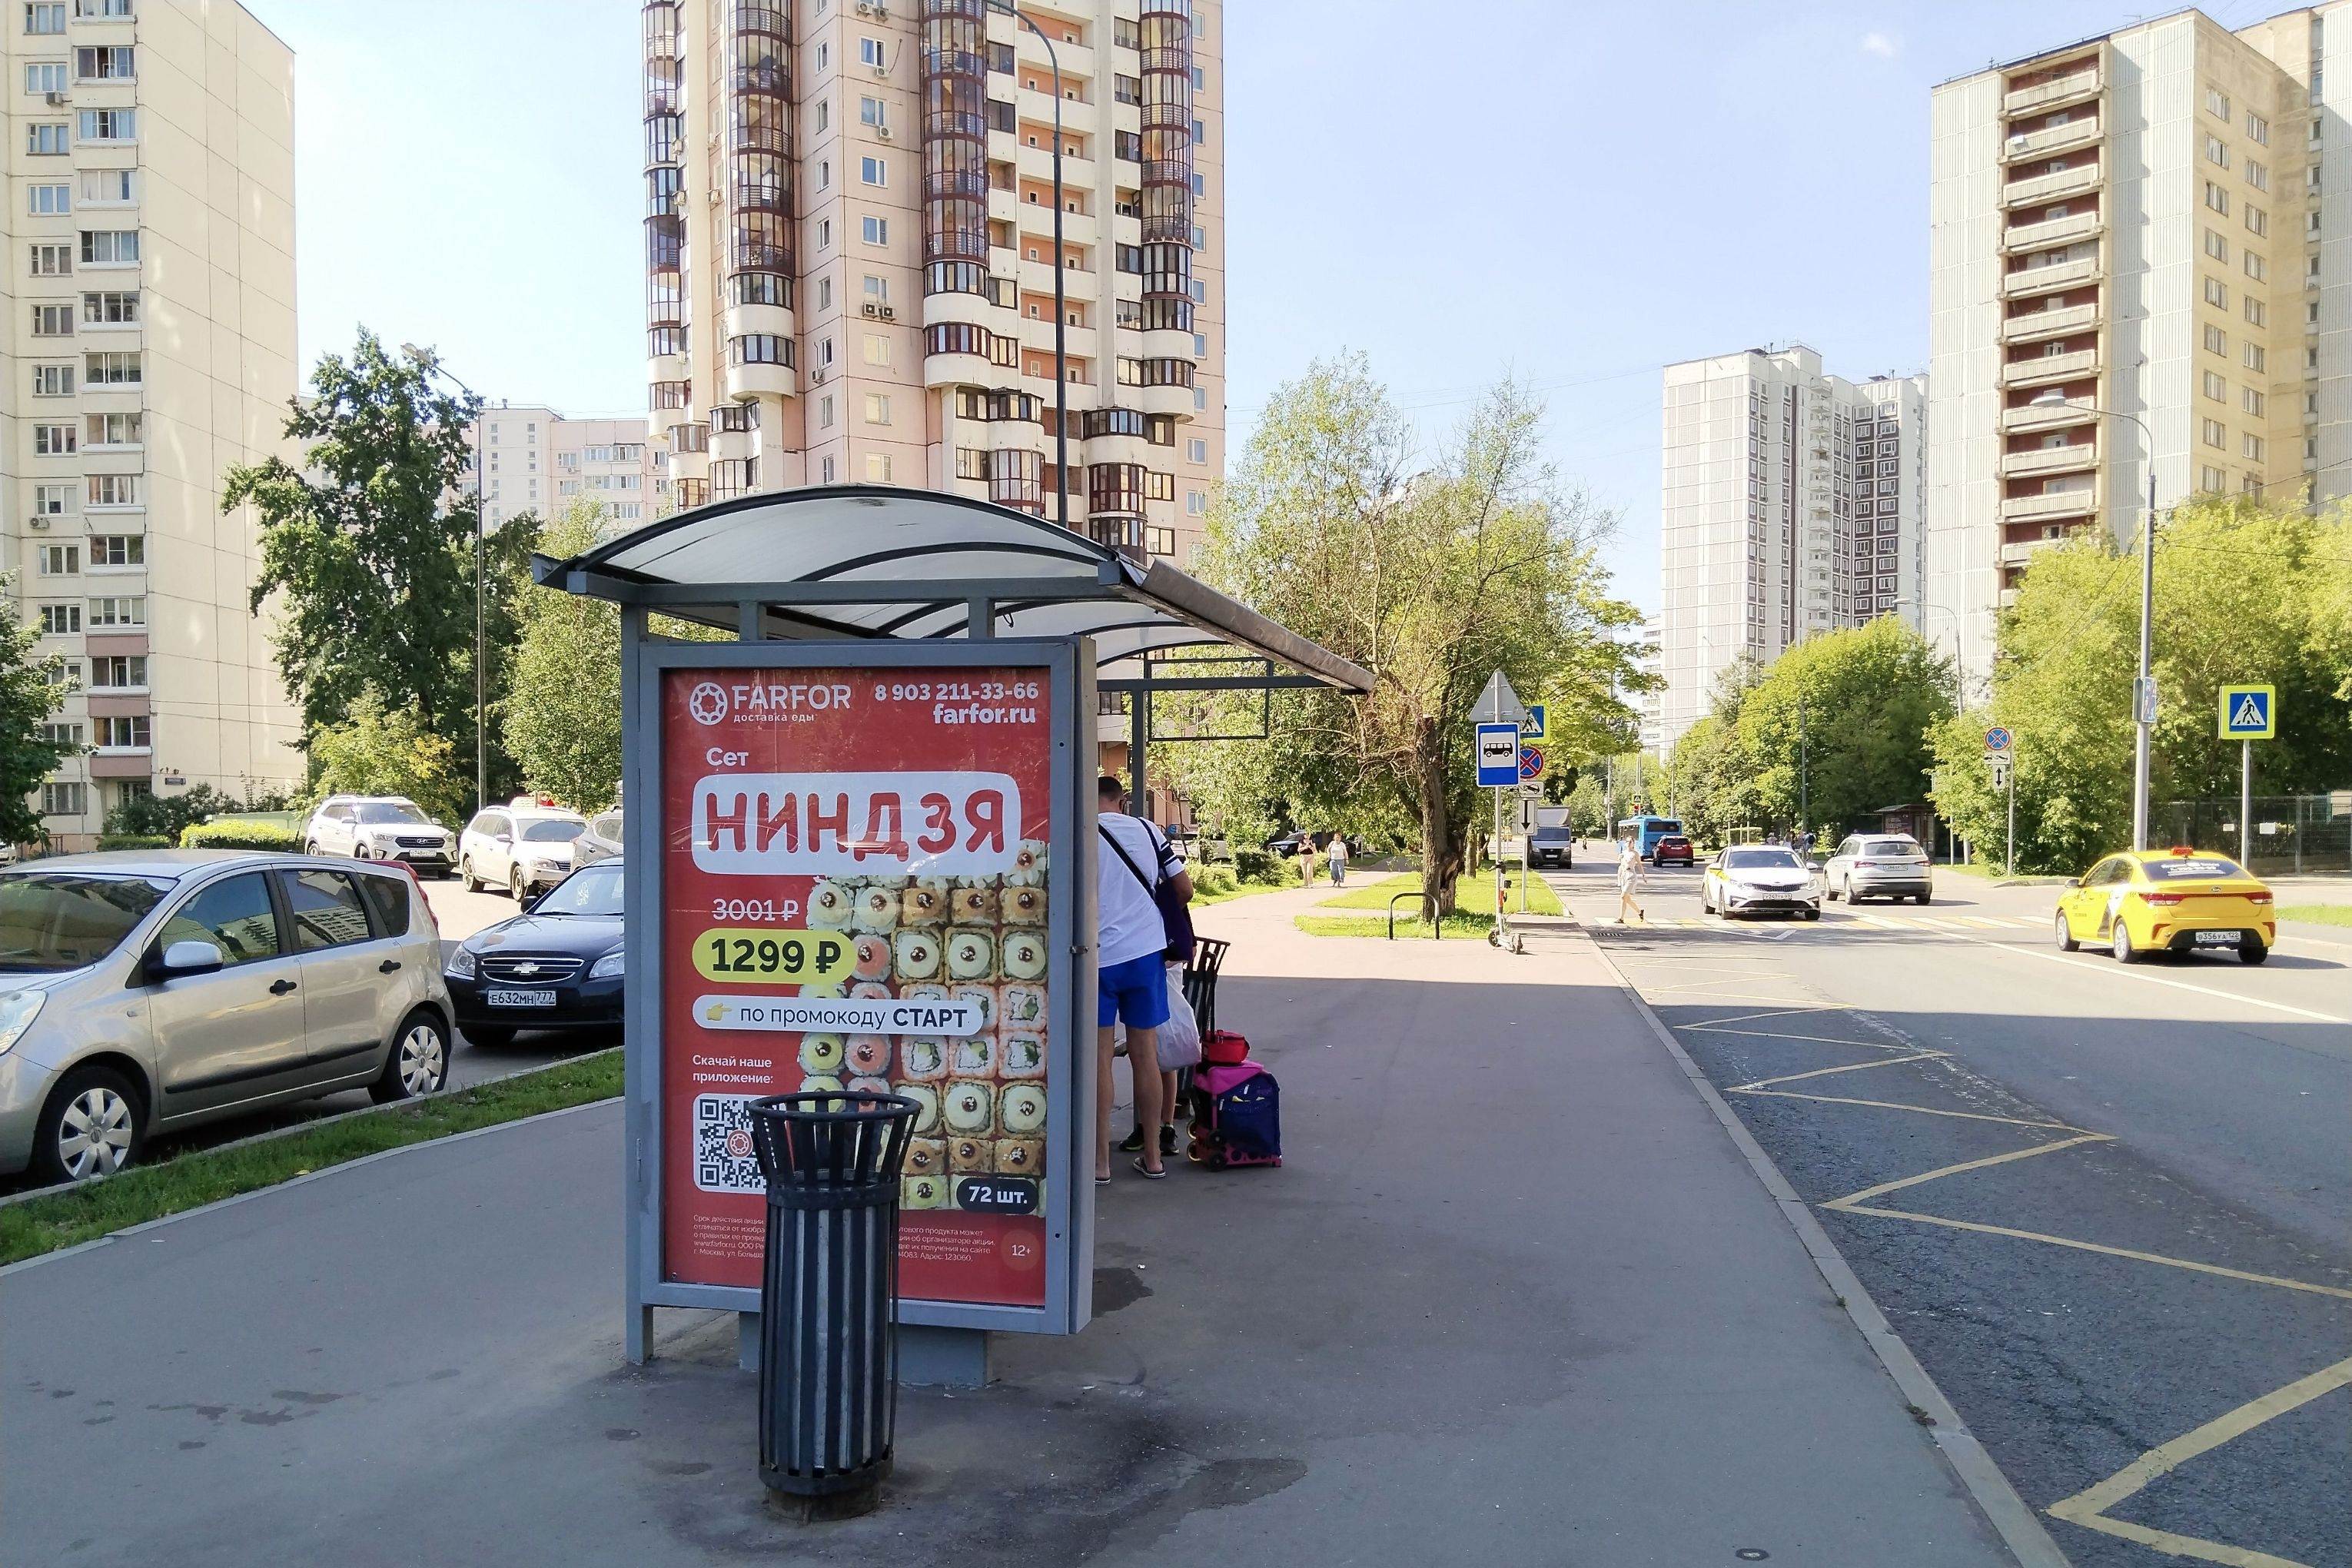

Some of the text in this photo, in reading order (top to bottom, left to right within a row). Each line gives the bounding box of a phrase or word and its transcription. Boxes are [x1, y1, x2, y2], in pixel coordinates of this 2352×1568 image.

[732, 685, 852, 709] FARFOR
[875, 683, 1038, 701] 8 903 211-33-66
[733, 714, 815, 723] доставка еды
[933, 703, 1036, 724] farfor.ru
[706, 747, 749, 767] Сет
[706, 789, 1005, 862] НИНДЗЯ
[713, 899, 776, 921] 3001
[712, 938, 805, 973] 1299
[491, 992, 553, 1005] Е632МН 777
[740, 1008, 968, 1030] по промокоду СТАРТ
[693, 1055, 772, 1068] Скачай наше
[693, 1073, 774, 1084] приложение:
[968, 1186, 1027, 1204] 72 шт.
[1012, 1244, 1031, 1256] 12+
